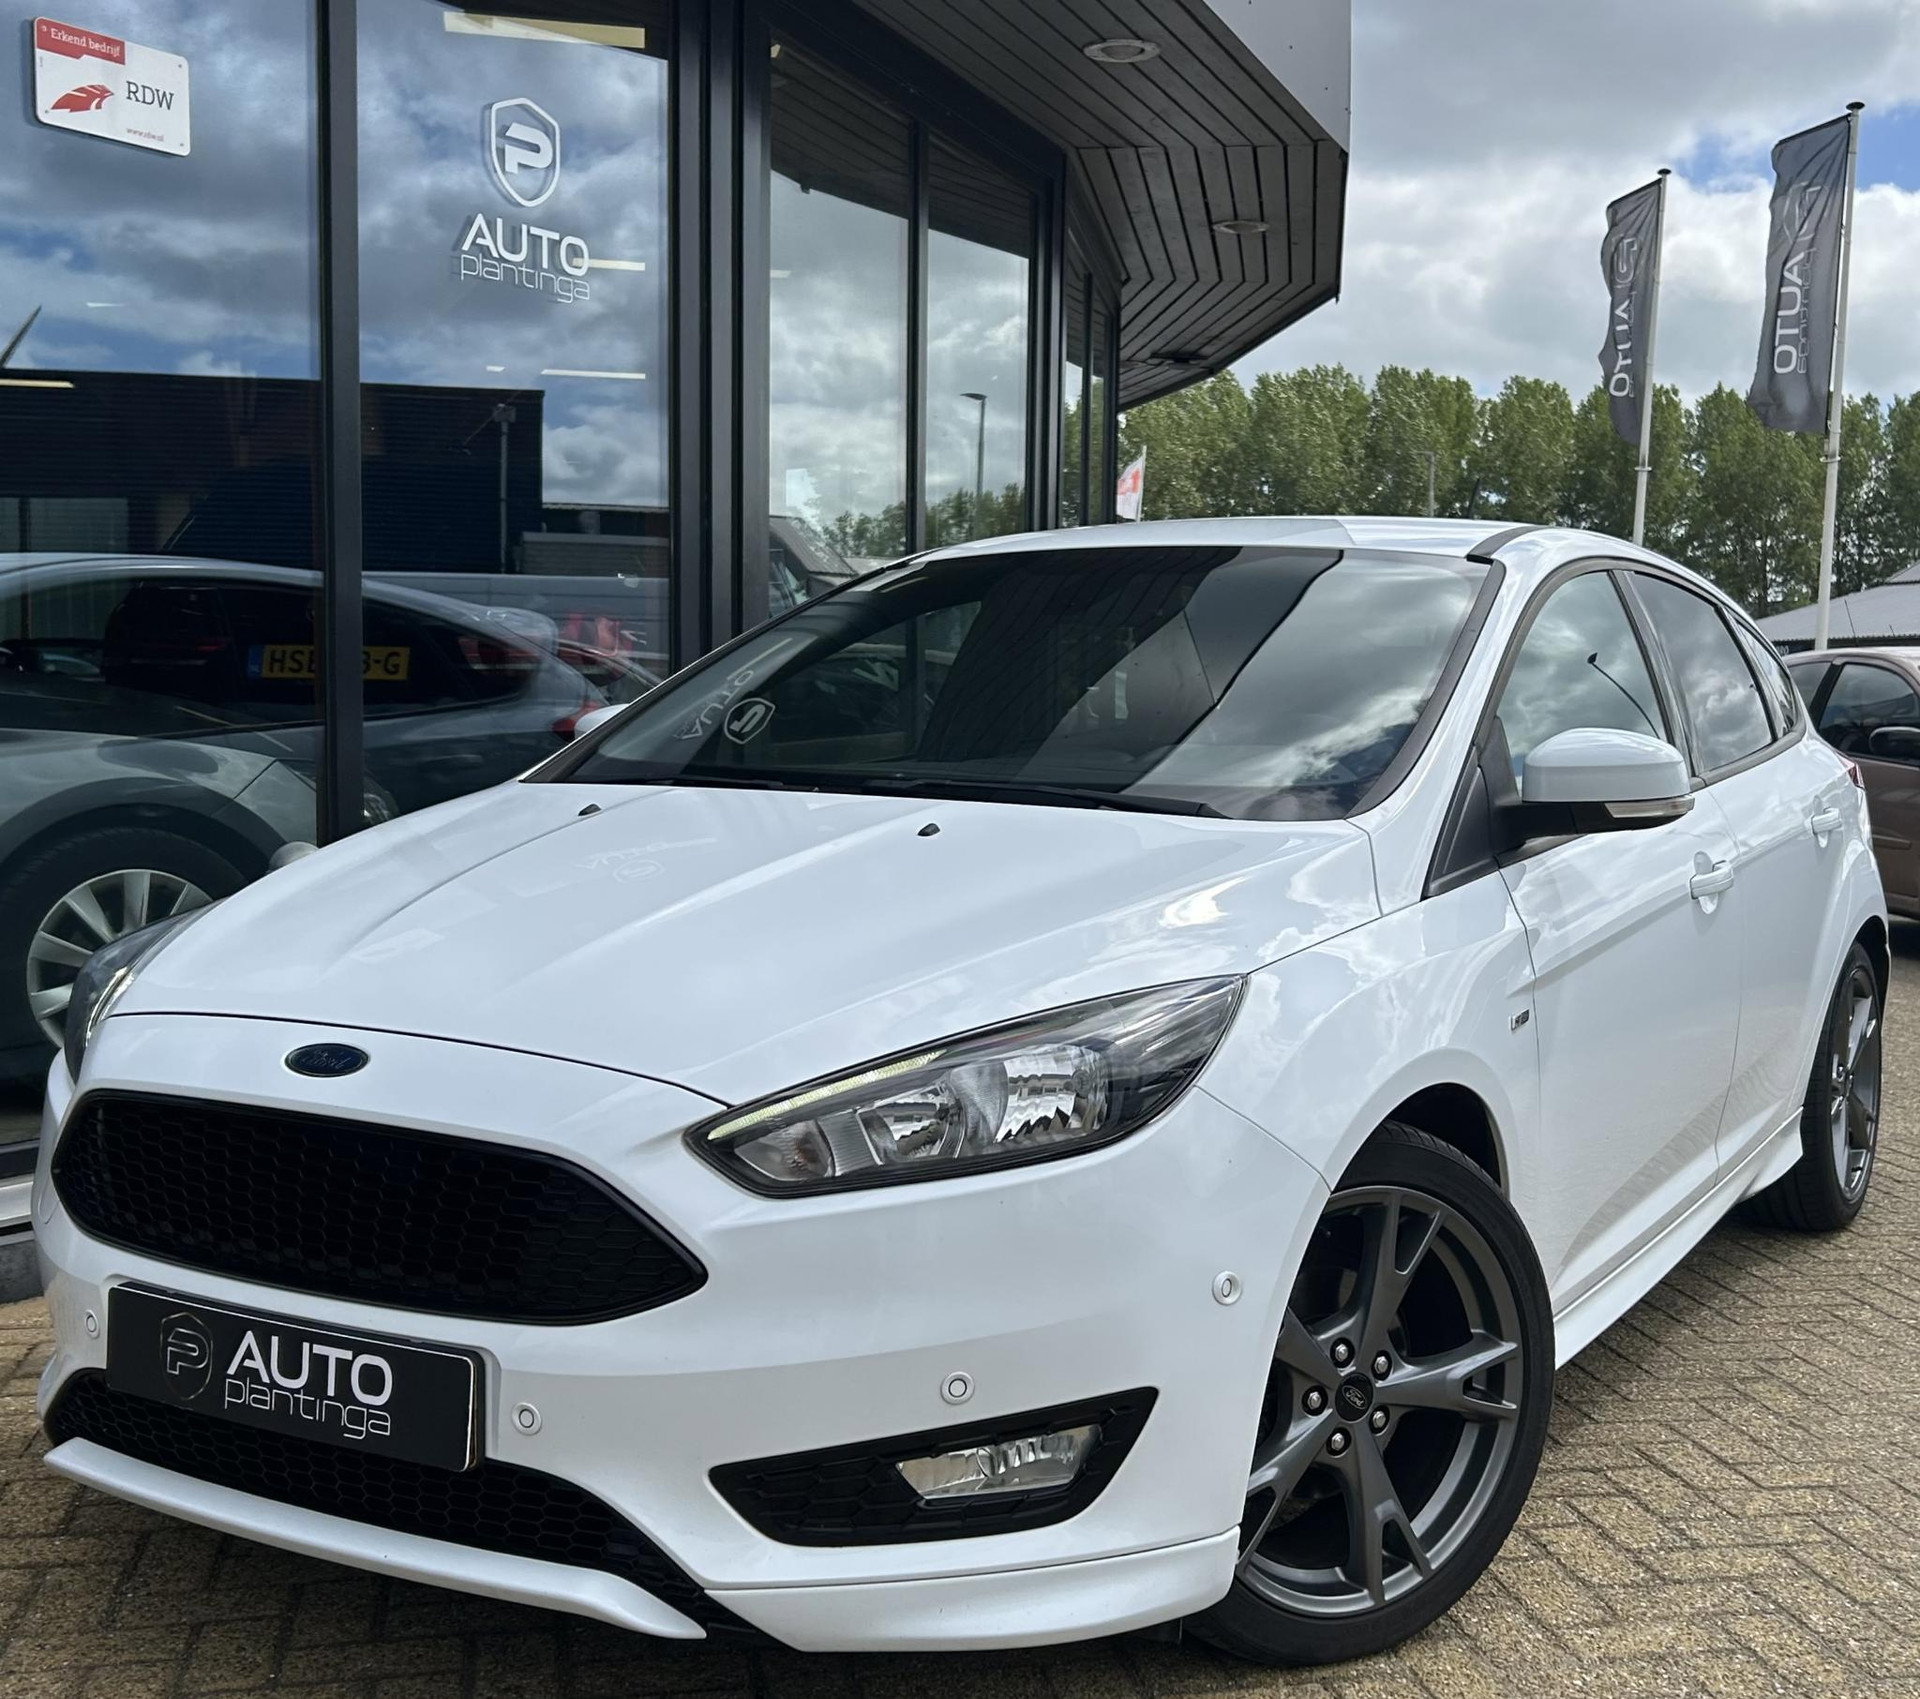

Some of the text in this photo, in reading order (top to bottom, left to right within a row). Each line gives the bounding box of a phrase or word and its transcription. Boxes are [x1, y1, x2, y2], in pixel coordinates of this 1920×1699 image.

[50, 27, 121, 57] Erkend bedrijf
[126, 80, 175, 111] RDW
[461, 212, 590, 276] AUTO
[460, 253, 591, 304] plantinga
[226, 1329, 393, 1407] AUTO
[224, 1378, 391, 1440] plantinga
